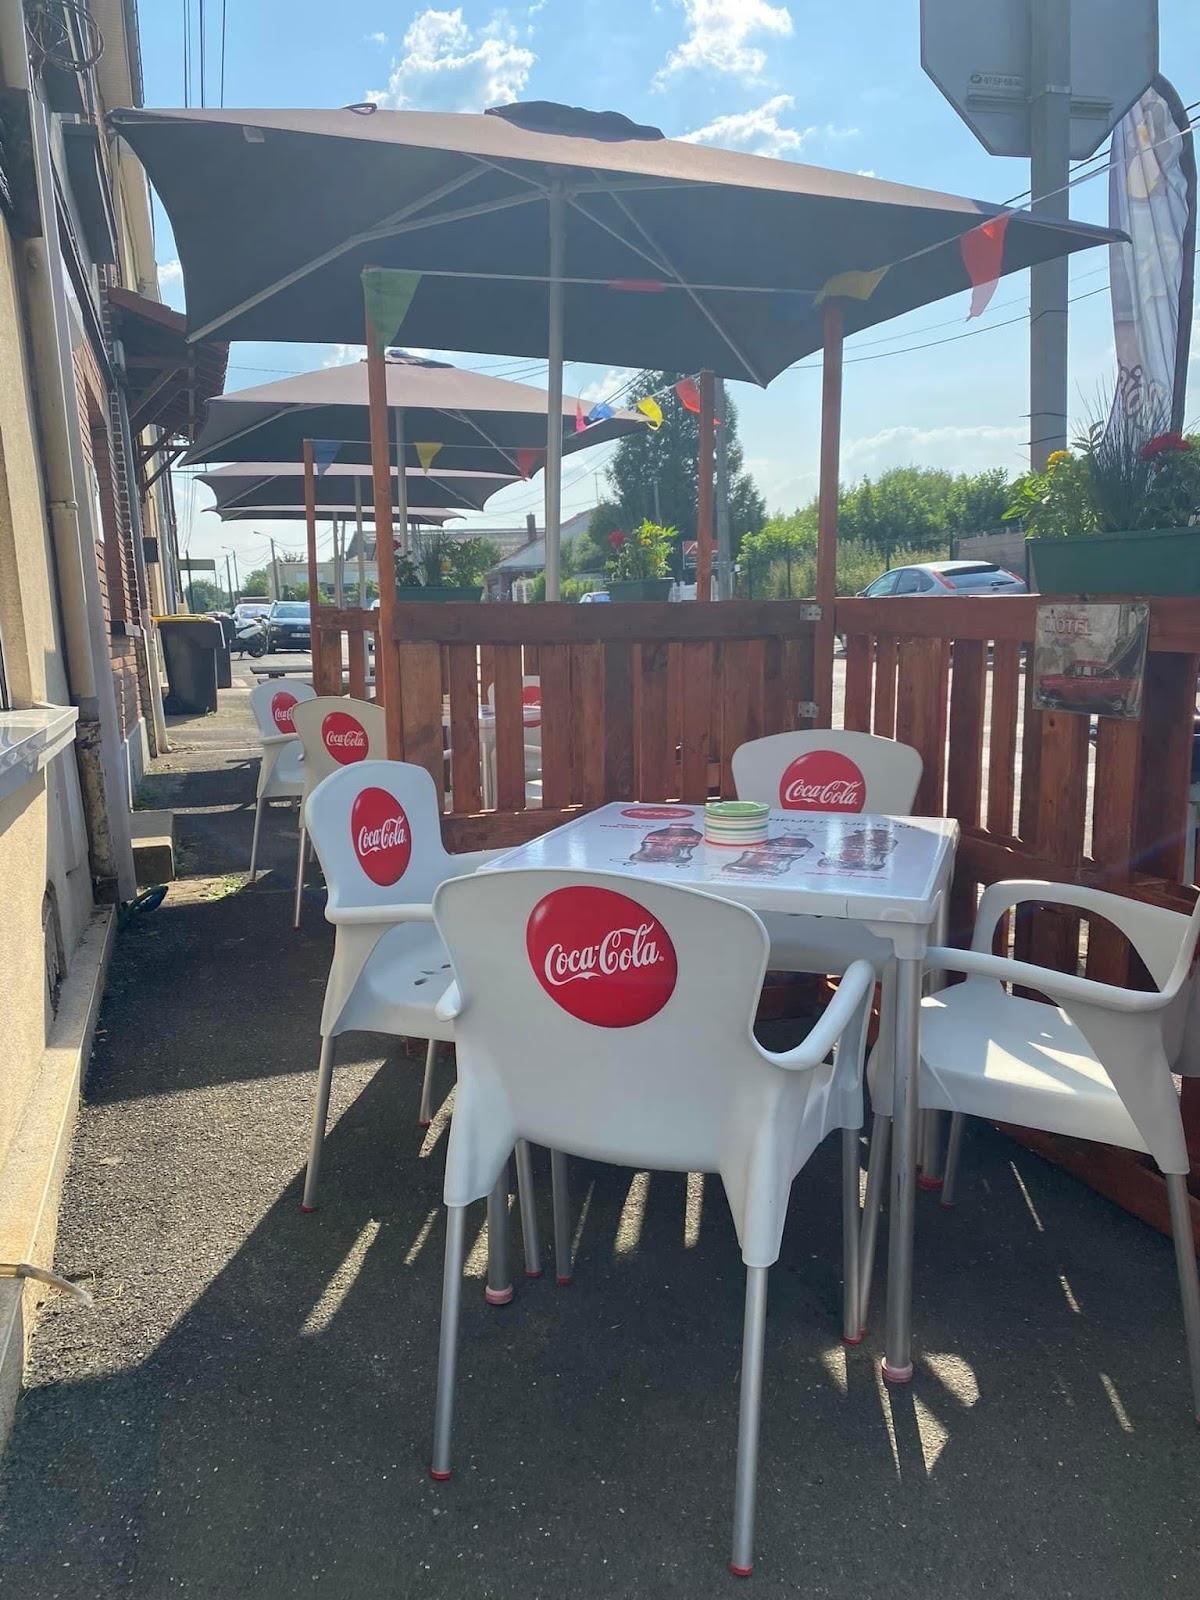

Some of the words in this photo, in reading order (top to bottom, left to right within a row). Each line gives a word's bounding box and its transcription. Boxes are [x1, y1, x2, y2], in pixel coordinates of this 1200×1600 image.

[326, 730, 365, 747] Coca-Cola
[785, 778, 862, 805] Coca-Cola
[358, 815, 407, 856] Coca-Cola
[544, 921, 662, 986] Coca-Cola
